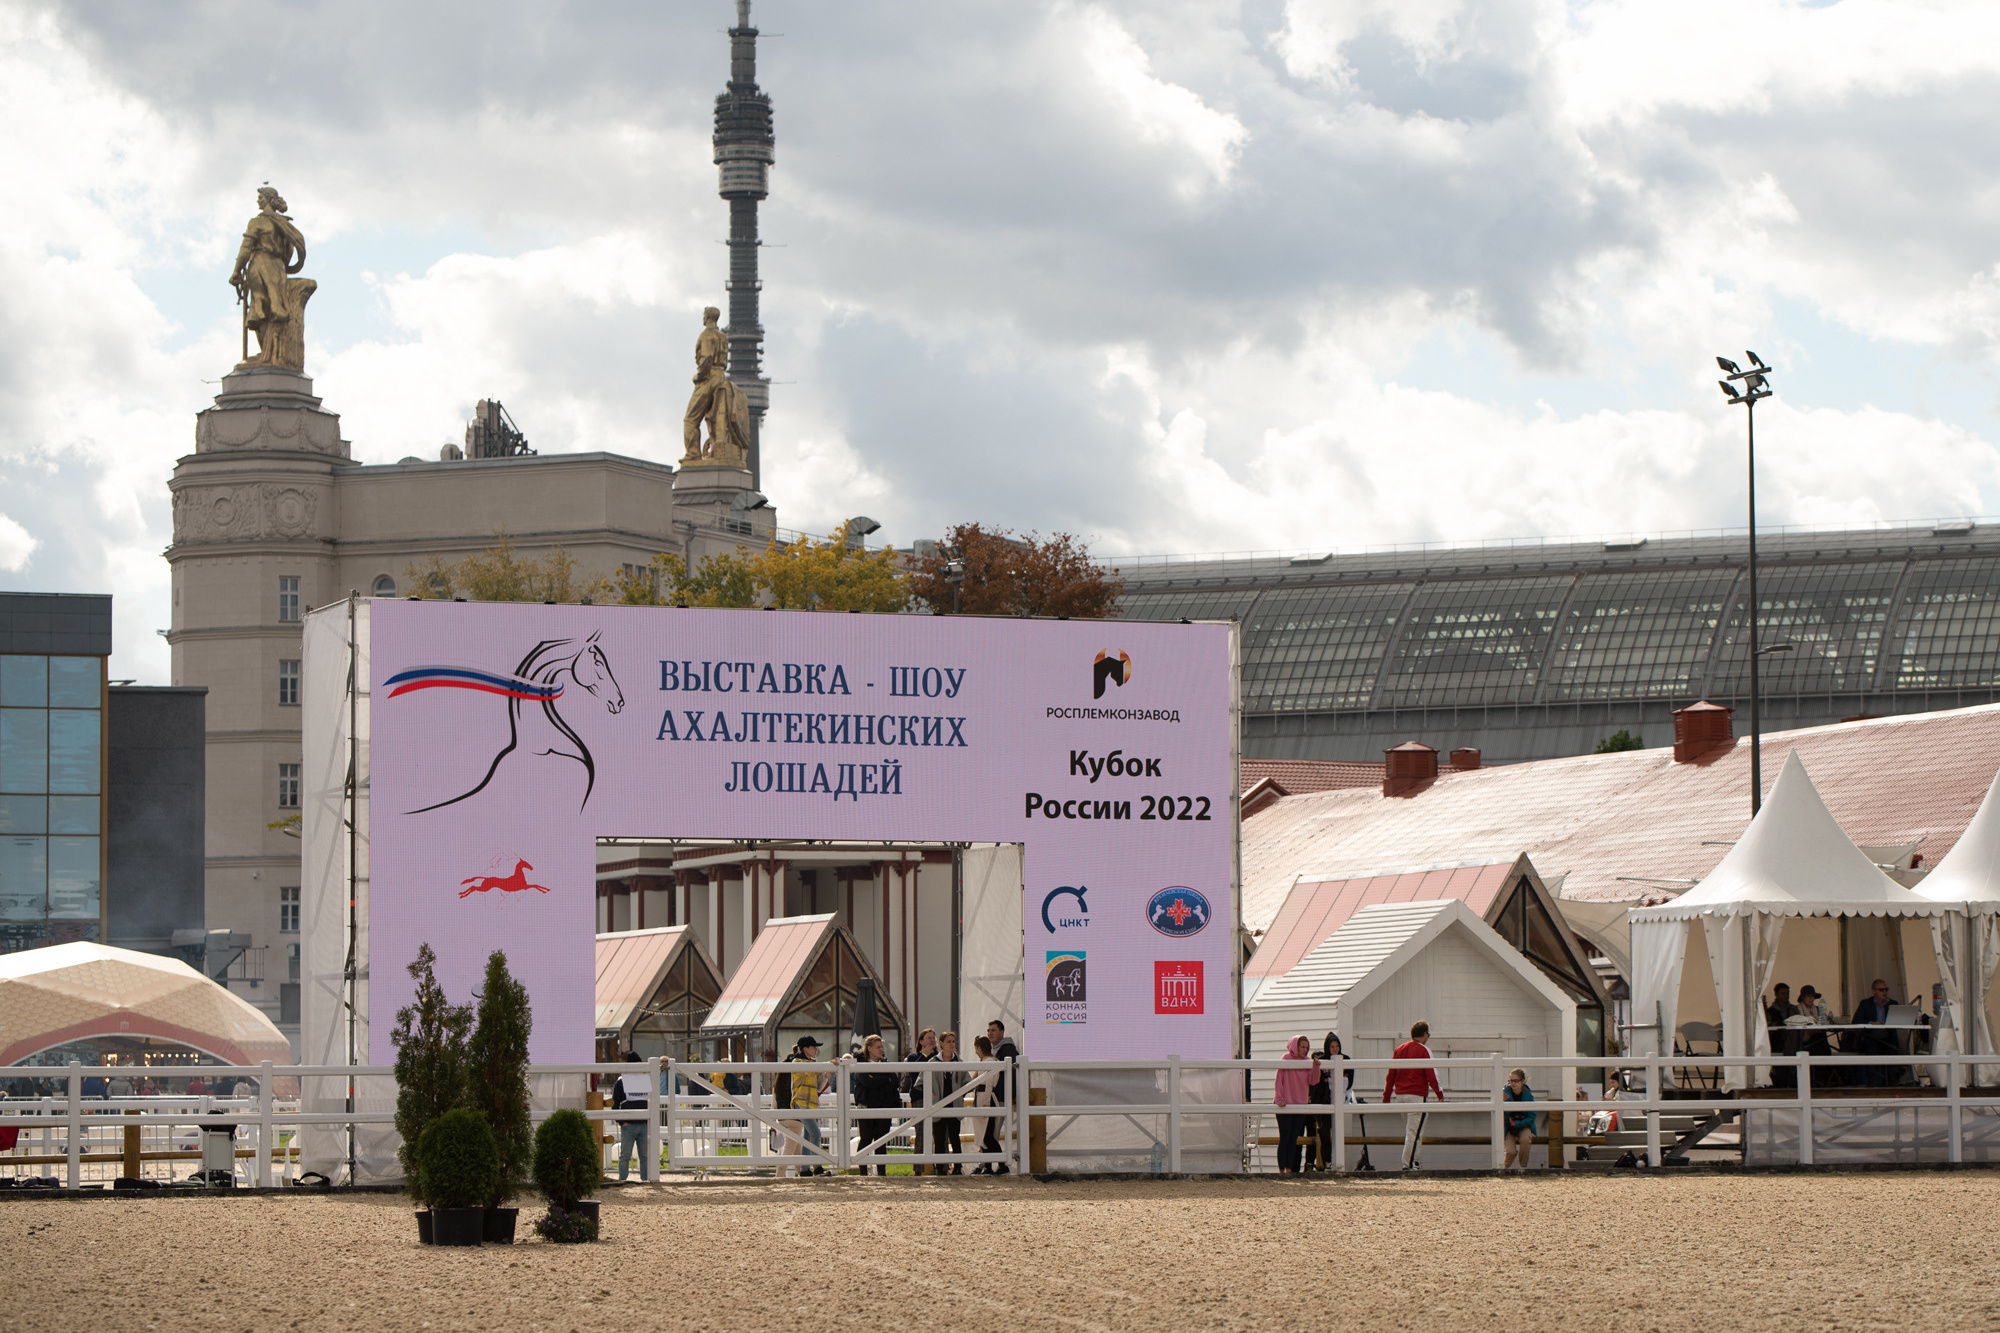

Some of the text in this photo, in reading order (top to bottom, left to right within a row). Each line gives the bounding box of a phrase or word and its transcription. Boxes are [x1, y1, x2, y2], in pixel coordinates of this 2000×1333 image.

[658, 660, 852, 695] ВЫСТАВКА
[889, 666, 967, 698] ШОУ
[656, 710, 968, 747] АХАЛТЕКИНСКИХ
[1046, 707, 1181, 723] РОСПЛЕМКОНЗАВОД
[724, 759, 903, 801] ЛОШАДЕЙ
[1069, 750, 1162, 784] Кубок
[1025, 792, 1211, 821] России 2022
[1059, 918, 1090, 928] ЦНКТ
[1161, 997, 1197, 1007] ВДНХ
